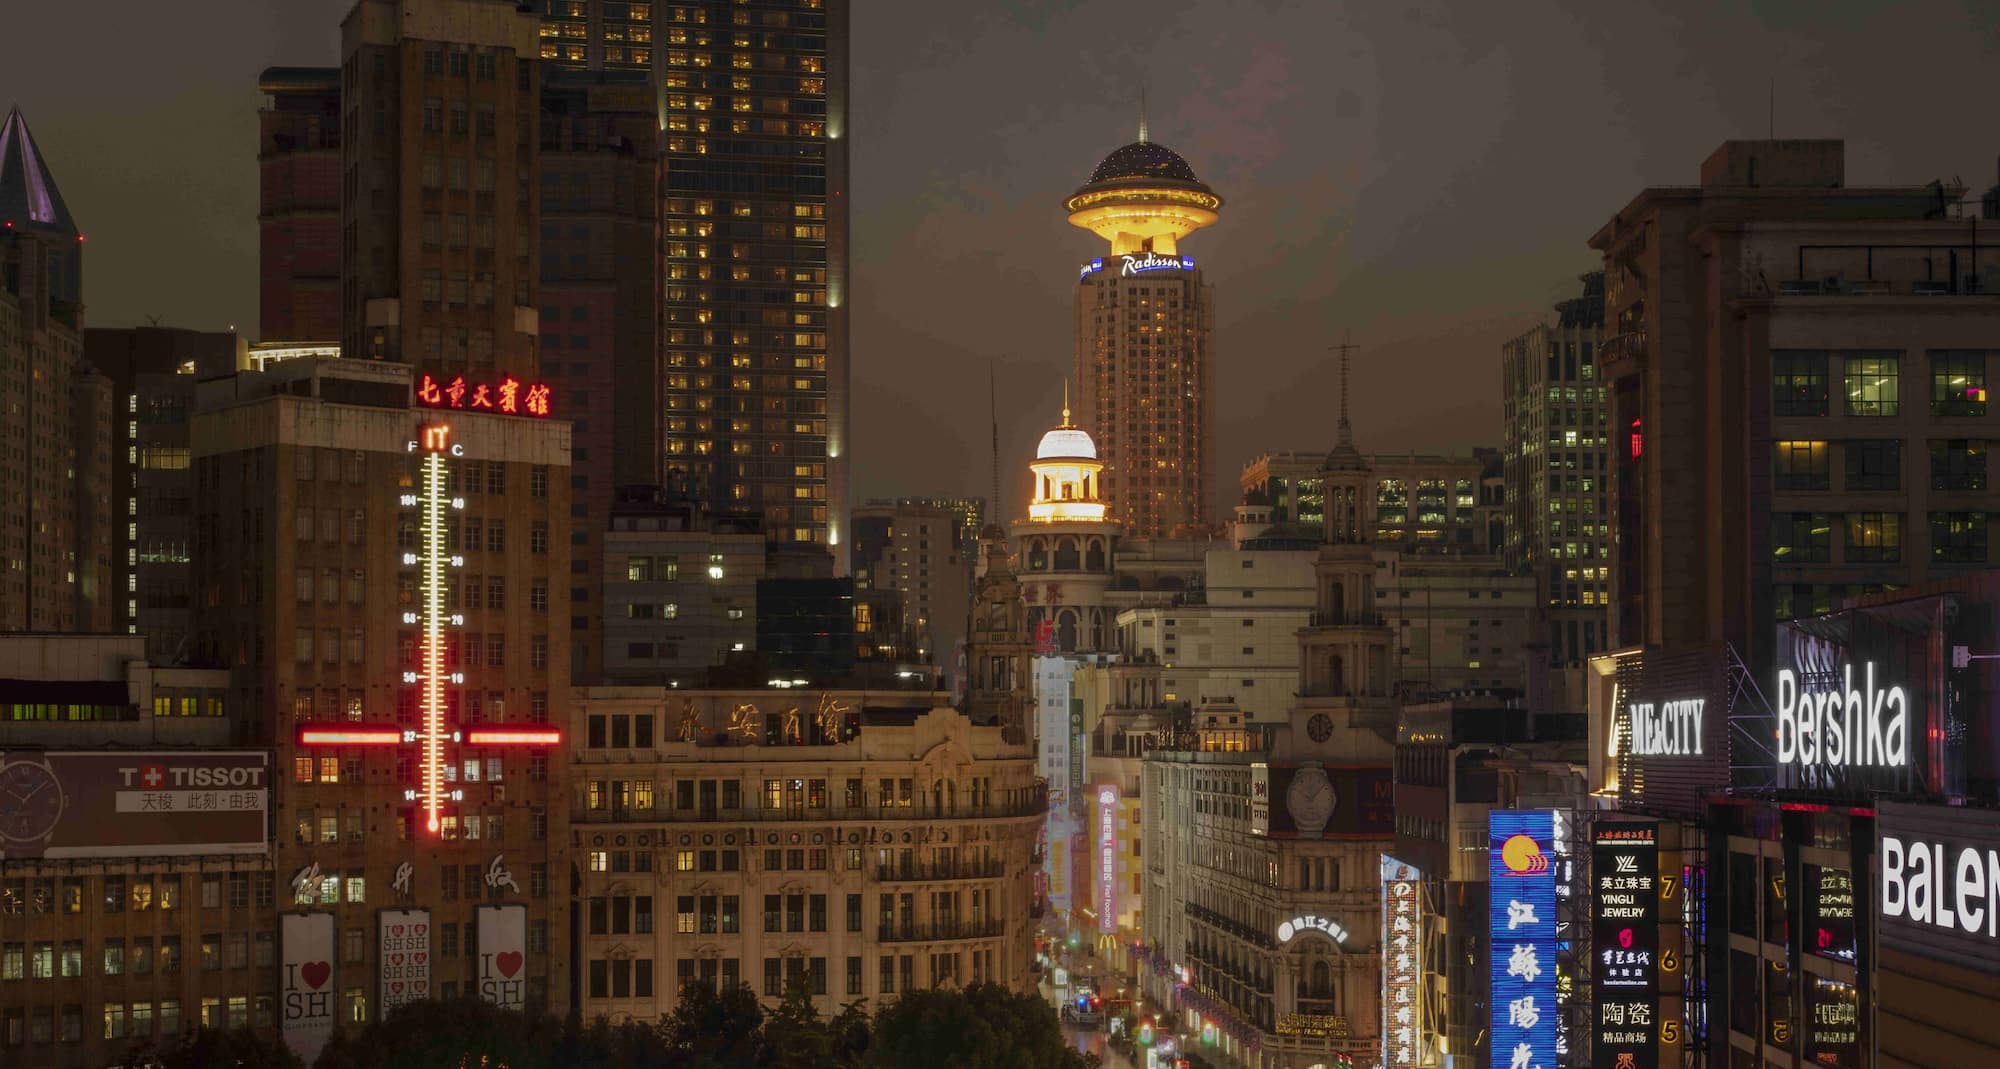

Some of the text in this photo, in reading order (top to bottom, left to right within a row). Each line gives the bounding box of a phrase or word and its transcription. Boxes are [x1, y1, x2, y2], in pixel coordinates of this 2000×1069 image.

[1121, 252, 1182, 277] Radisson
[407, 440, 418, 452] F
[452, 444, 464, 457] C
[1779, 661, 1906, 767] Bershka
[169, 767, 264, 786] TISSOT
[142, 793, 174, 810] 天梭
[1601, 877, 1652, 890] 英立珠宝
[1661, 875, 1678, 899] 7
[1601, 894, 1634, 905] YINGLI
[1601, 907, 1645, 918] JEWELRY
[1661, 949, 1679, 972] 6
[285, 992, 330, 1020] SH
[1602, 1002, 1651, 1025] 陶瓷
[1602, 1031, 1647, 1044] 精品商场
[1661, 1020, 1679, 1044] 5
